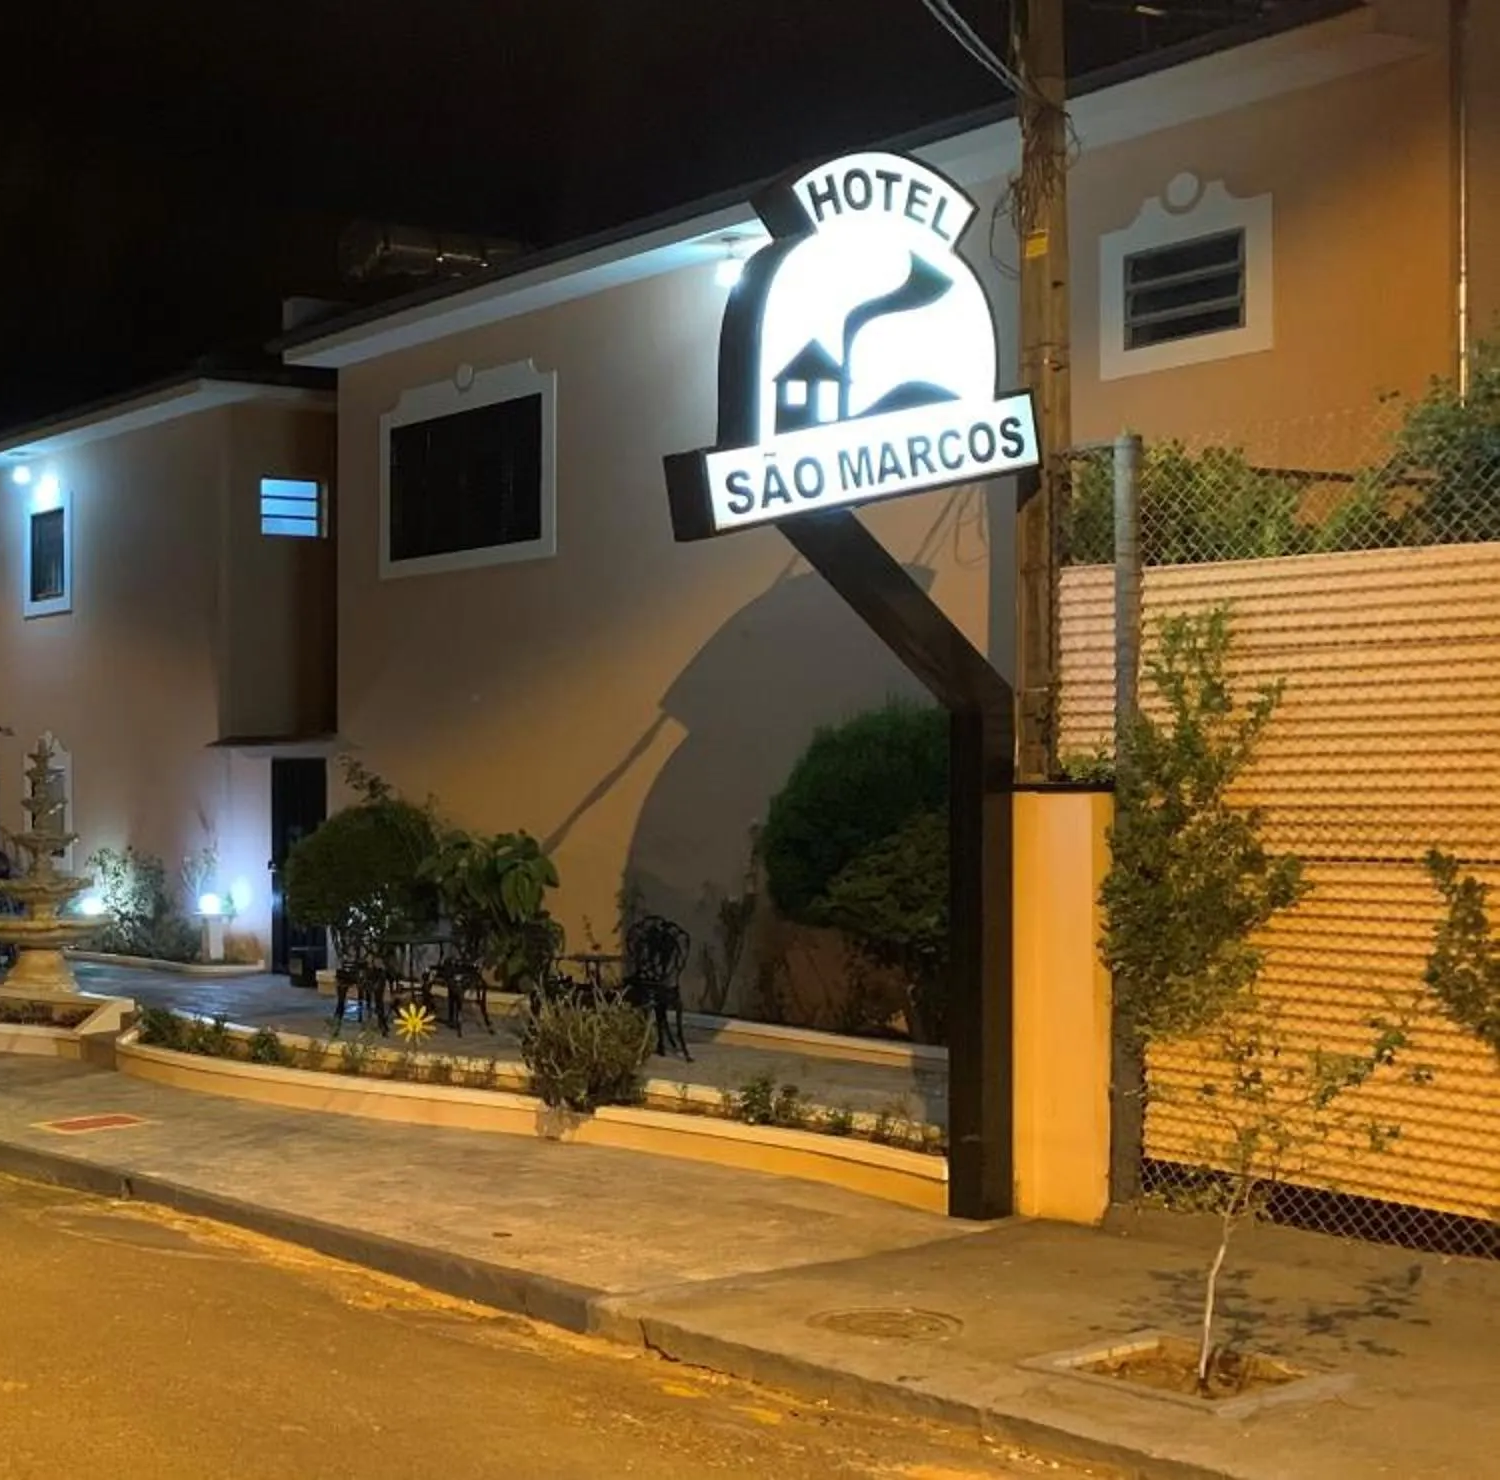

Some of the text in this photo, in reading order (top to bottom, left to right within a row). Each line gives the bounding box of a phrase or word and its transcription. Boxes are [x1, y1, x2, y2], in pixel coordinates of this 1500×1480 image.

[806, 167, 950, 242] HOTEL
[725, 416, 1025, 515] SÃO MARCOS
